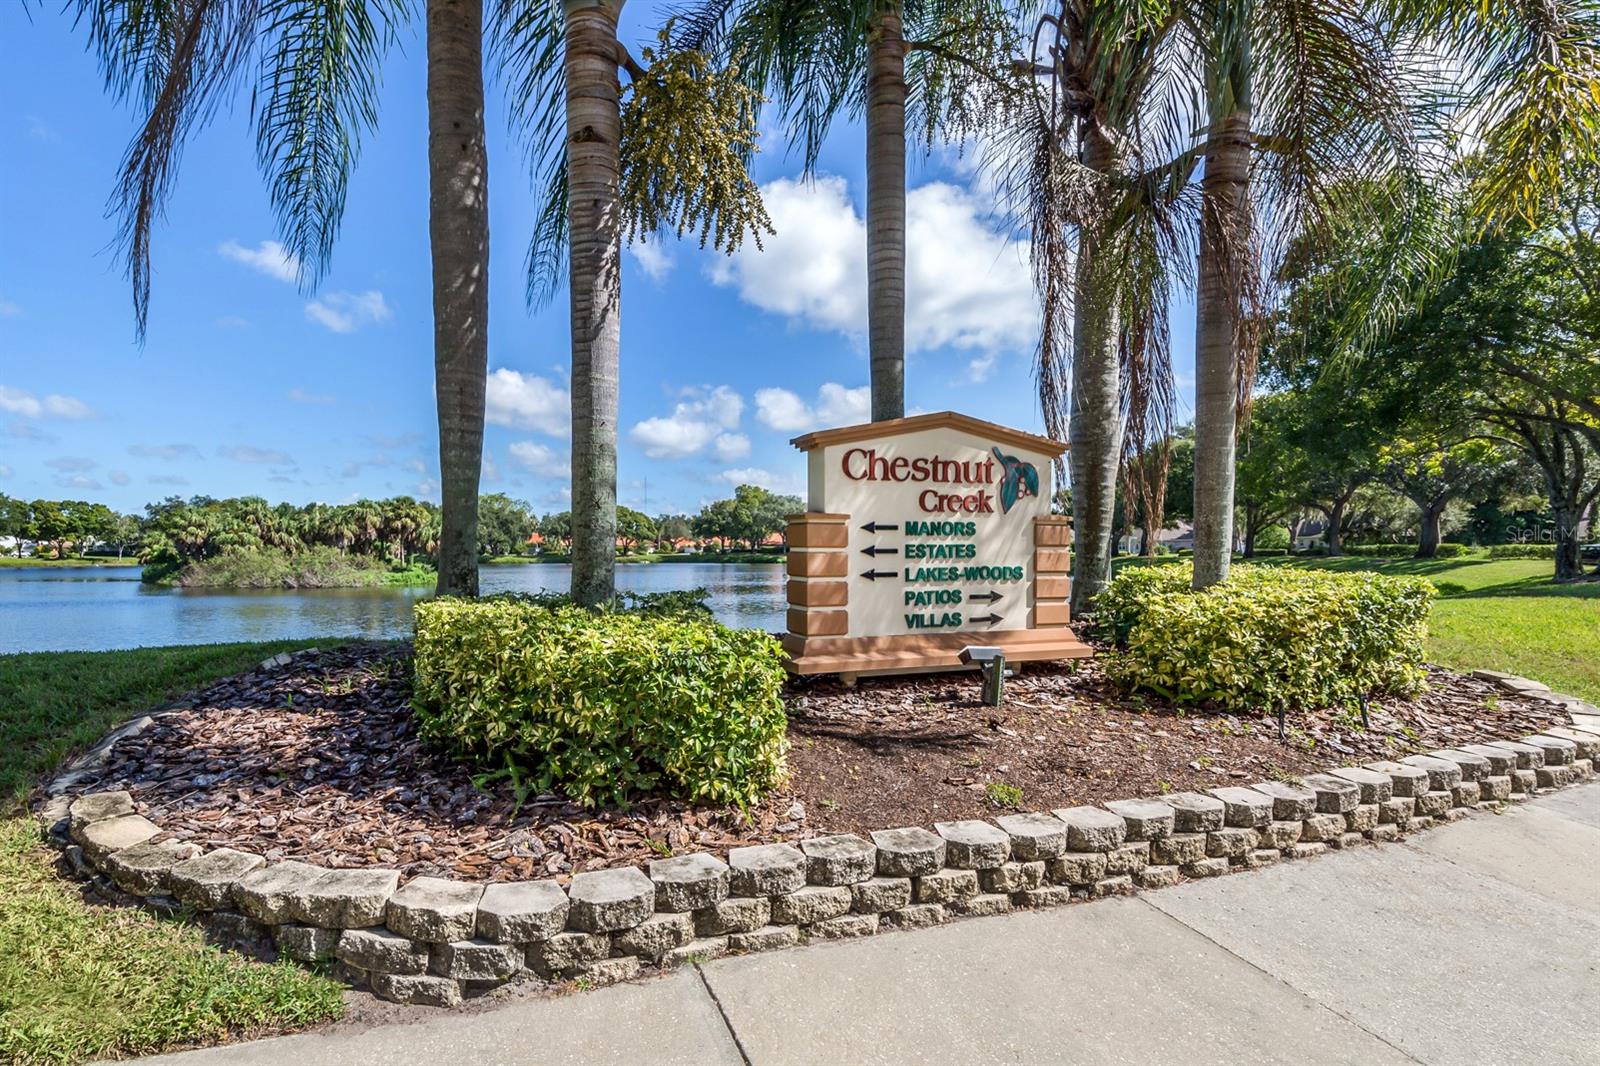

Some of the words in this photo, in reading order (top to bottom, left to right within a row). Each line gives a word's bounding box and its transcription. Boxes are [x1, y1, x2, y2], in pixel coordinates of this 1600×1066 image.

[841, 448, 995, 484] Chestnut
[918, 490, 994, 513] Creek
[904, 521, 976, 536] MANORS
[904, 544, 976, 559] ESTATES
[904, 566, 1023, 582] LAKES-WOODS
[904, 590, 962, 605] PATIOS
[904, 613, 962, 628] VILLAS
